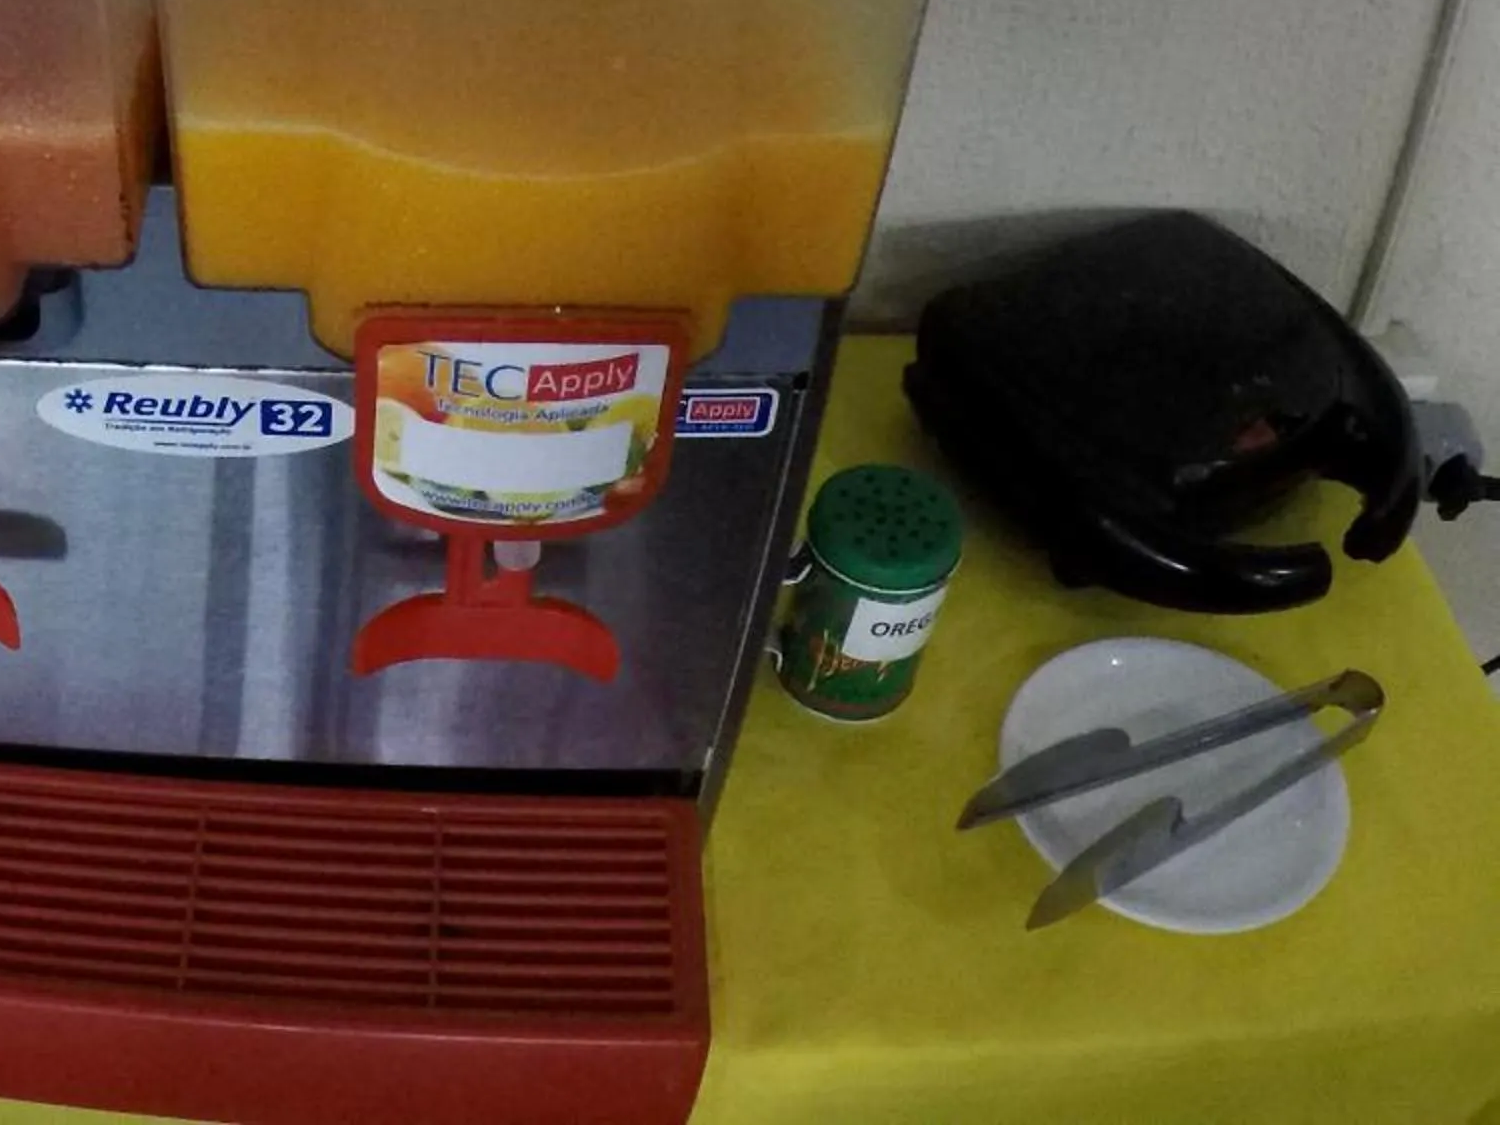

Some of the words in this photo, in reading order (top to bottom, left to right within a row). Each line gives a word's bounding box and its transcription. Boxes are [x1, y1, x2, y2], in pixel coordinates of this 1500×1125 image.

[418, 350, 526, 401] TEC
[532, 361, 634, 398] Apply
[102, 391, 257, 425] Reubly
[269, 402, 324, 432] 32
[691, 401, 754, 419] Apply
